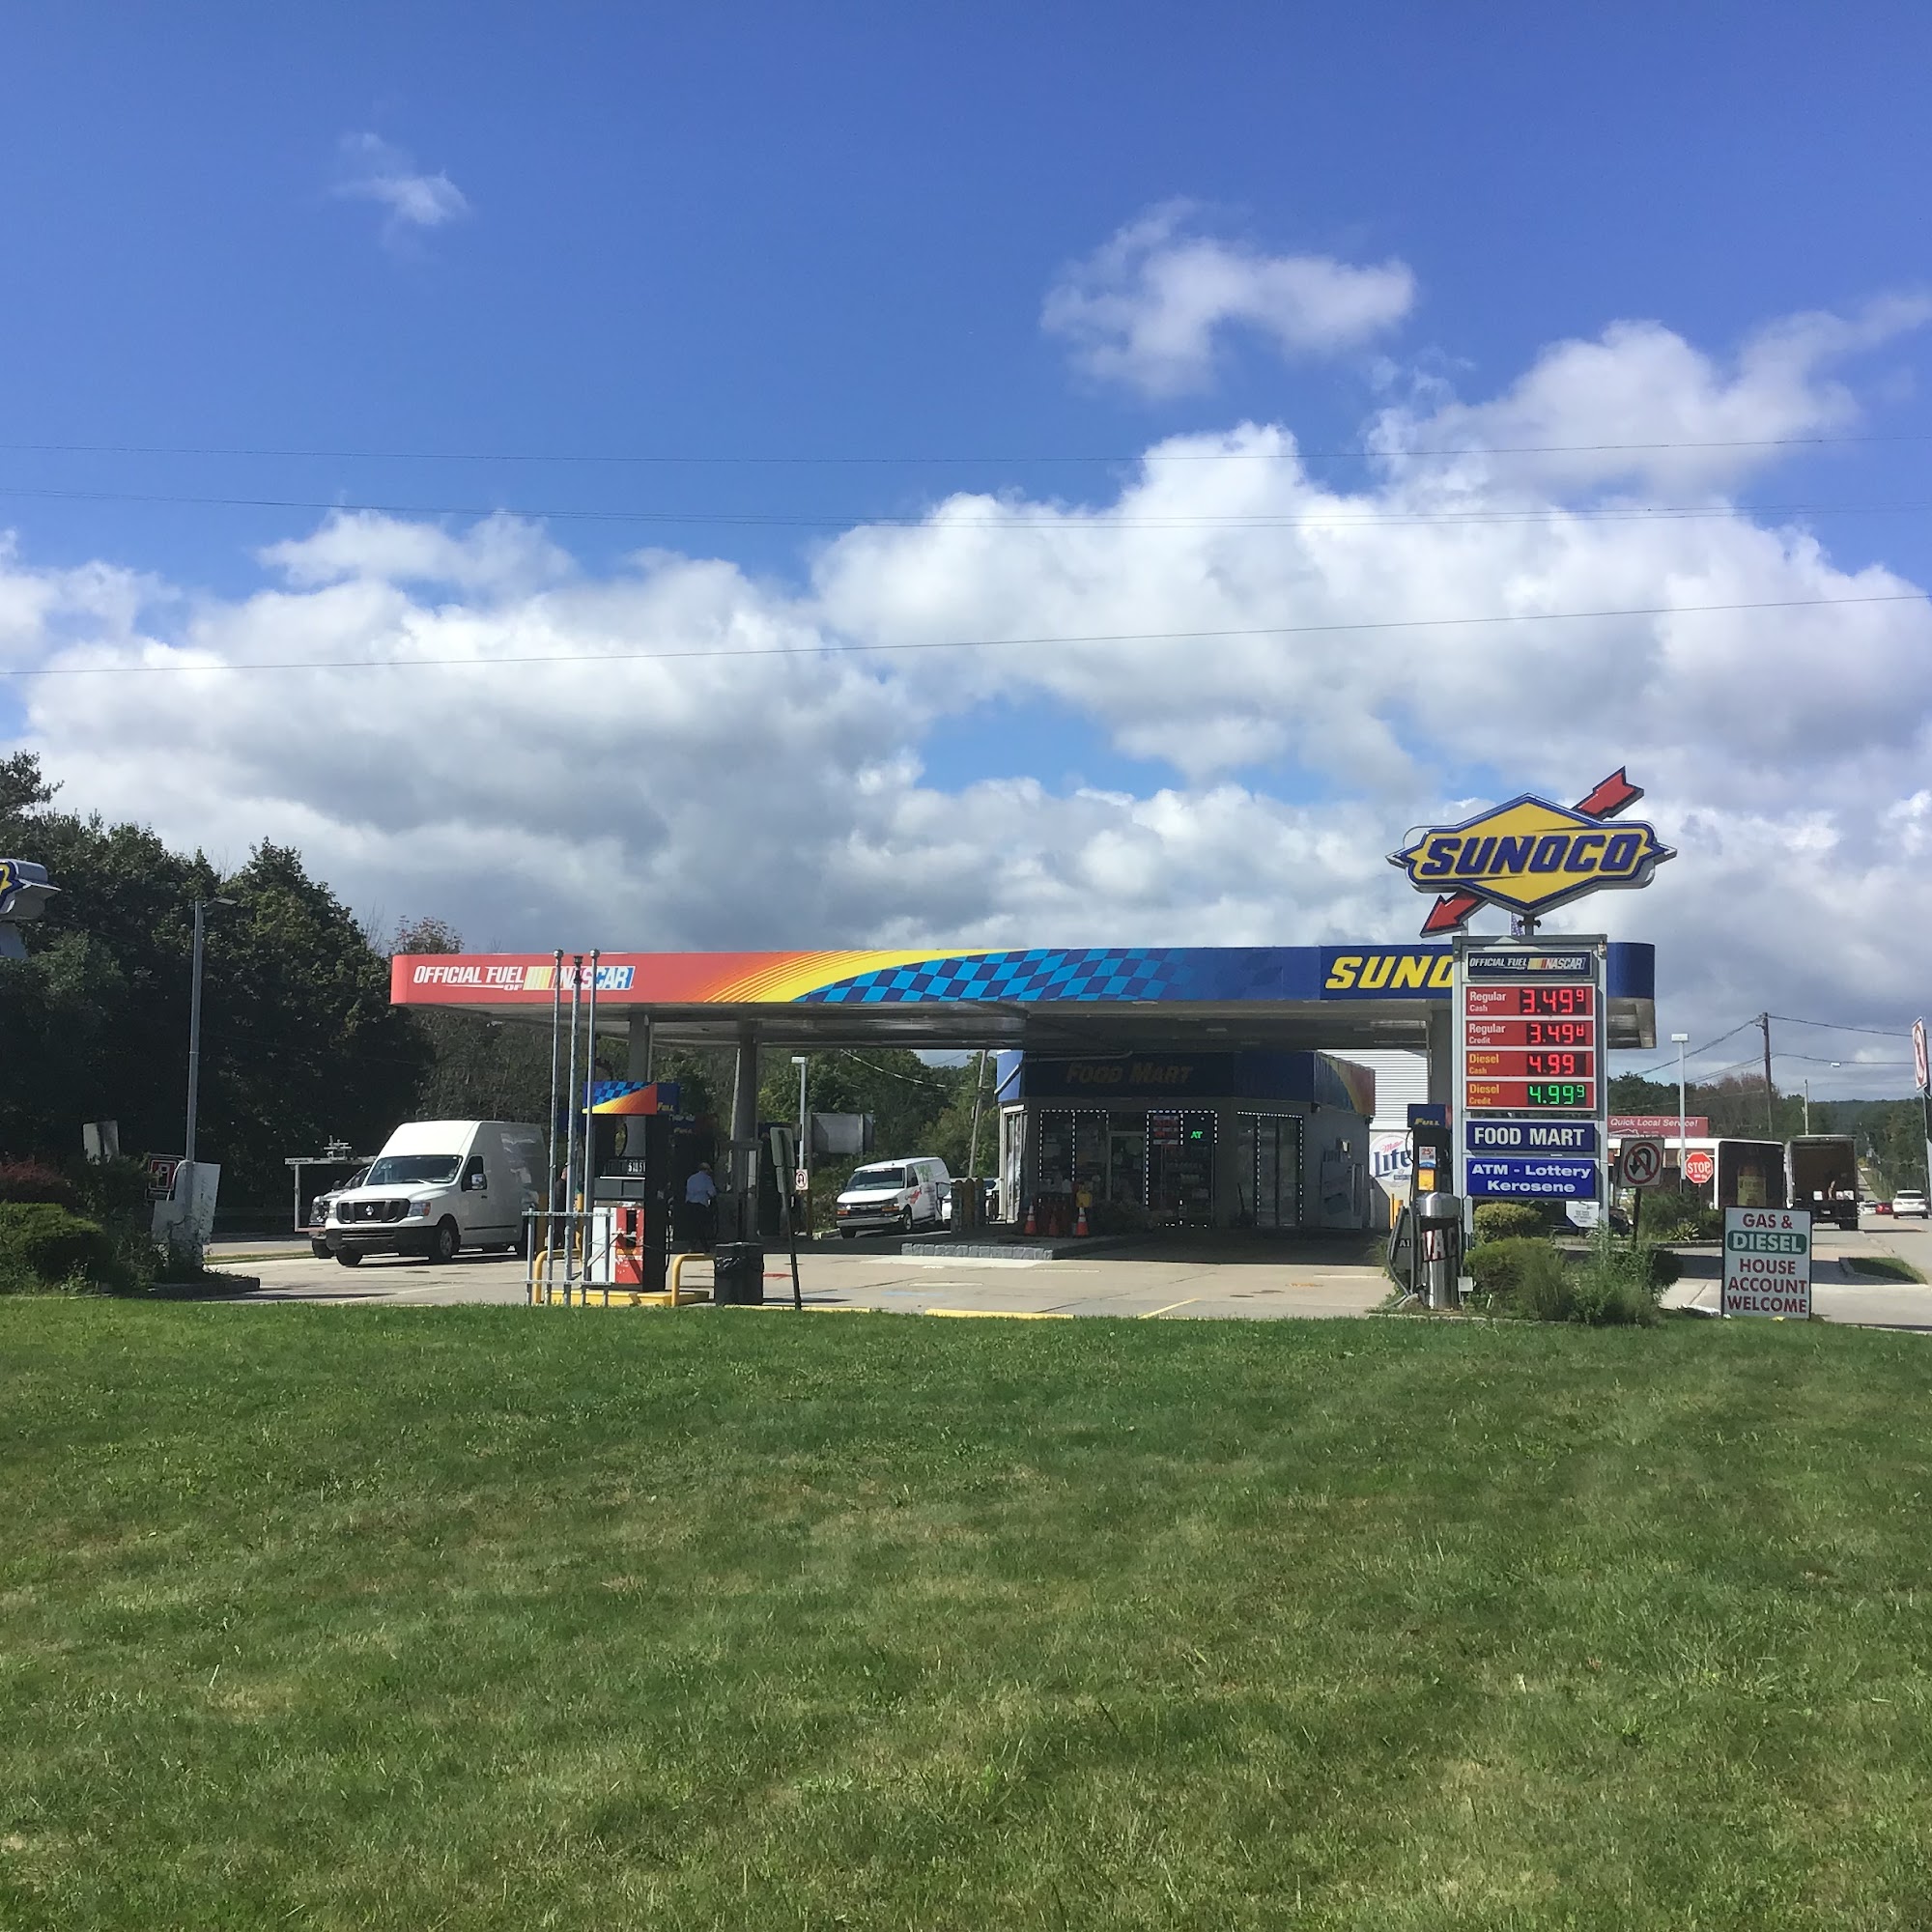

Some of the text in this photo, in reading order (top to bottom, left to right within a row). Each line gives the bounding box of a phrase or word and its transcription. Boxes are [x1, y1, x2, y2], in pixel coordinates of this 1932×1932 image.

[1420, 834, 1643, 875] SUNOCO
[1469, 957, 1583, 970] OFFICIAL FUEL NASCAR
[412, 965, 525, 984] OFFICIAL FUEL
[1469, 991, 1506, 1002] Regular
[1468, 1023, 1506, 1035] Regular
[1468, 1054, 1575, 1074] Diesel 4.99
[1469, 1084, 1500, 1094] Diesel
[1610, 1118, 1698, 1127] Quick Local Servce!
[1474, 1127, 1585, 1146] FOOD MART
[1471, 1164, 1508, 1175] ATM
[1525, 1165, 1591, 1179] Lottery
[1687, 1161, 1711, 1174] STOP
[1487, 1180, 1576, 1193] Kerosene
[1742, 1212, 1793, 1229] GAS &
[1732, 1233, 1802, 1252] DIESEL
[1740, 1258, 1796, 1275] HOUSE
[1727, 1276, 1807, 1294] ACCOUNT
[1727, 1295, 1807, 1313] WELCOME
